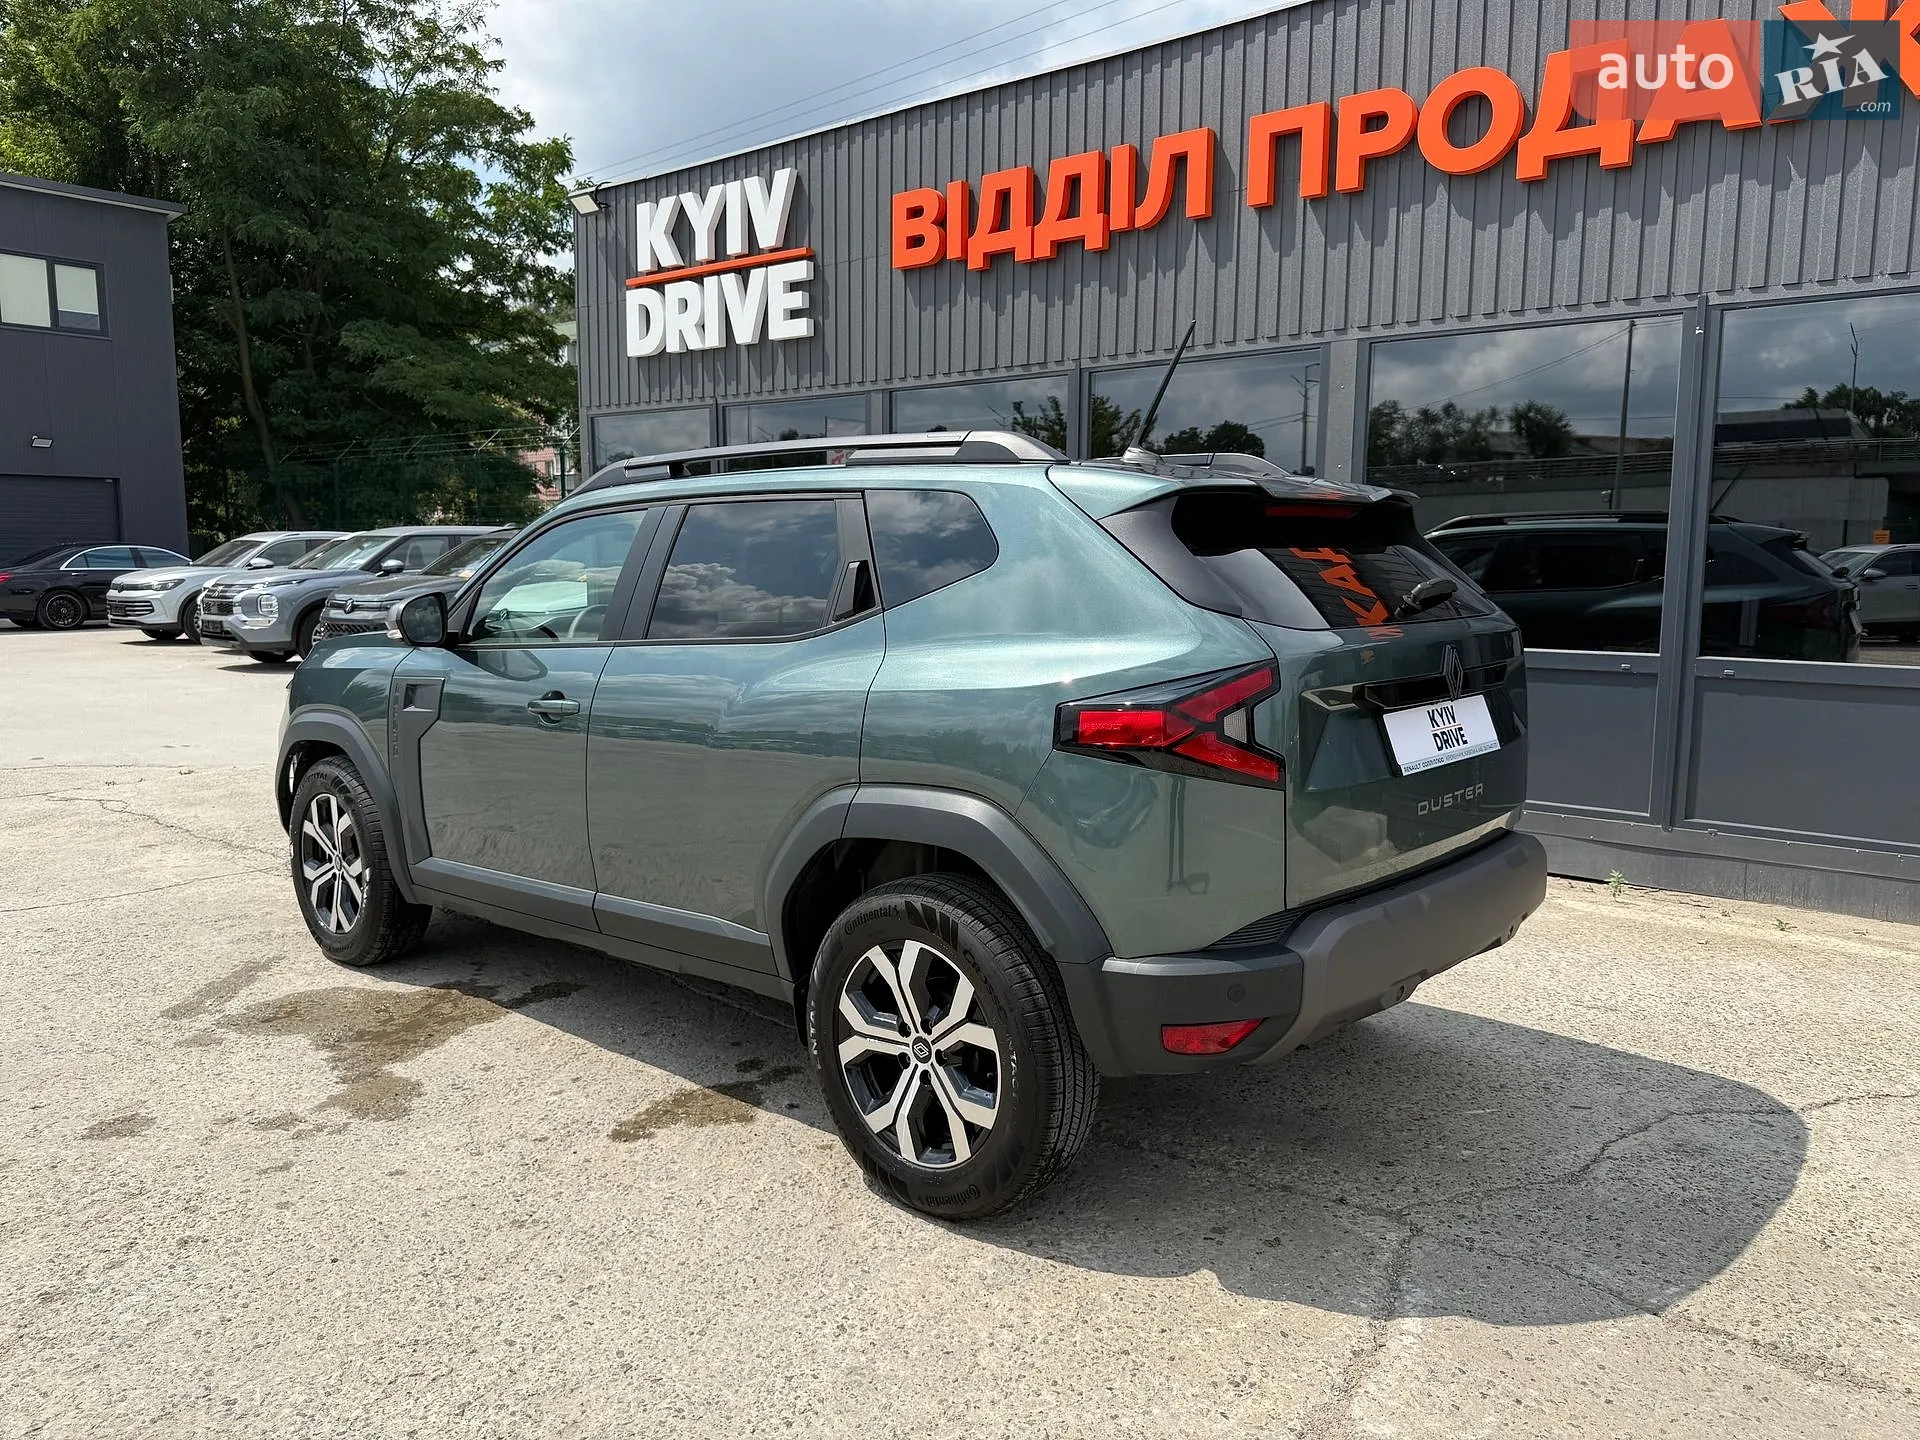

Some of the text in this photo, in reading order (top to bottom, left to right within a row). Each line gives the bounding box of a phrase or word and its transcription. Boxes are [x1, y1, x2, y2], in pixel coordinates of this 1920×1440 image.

[892, 127, 1215, 271] ВІДДІЛ
[636, 167, 799, 273] KYIV
[625, 259, 816, 358] DRIVE
[1426, 704, 1457, 729] KYIV
[1431, 726, 1469, 752] DRIVE
[1417, 783, 1484, 816] DUSTER
[844, 905, 891, 936] Continental
